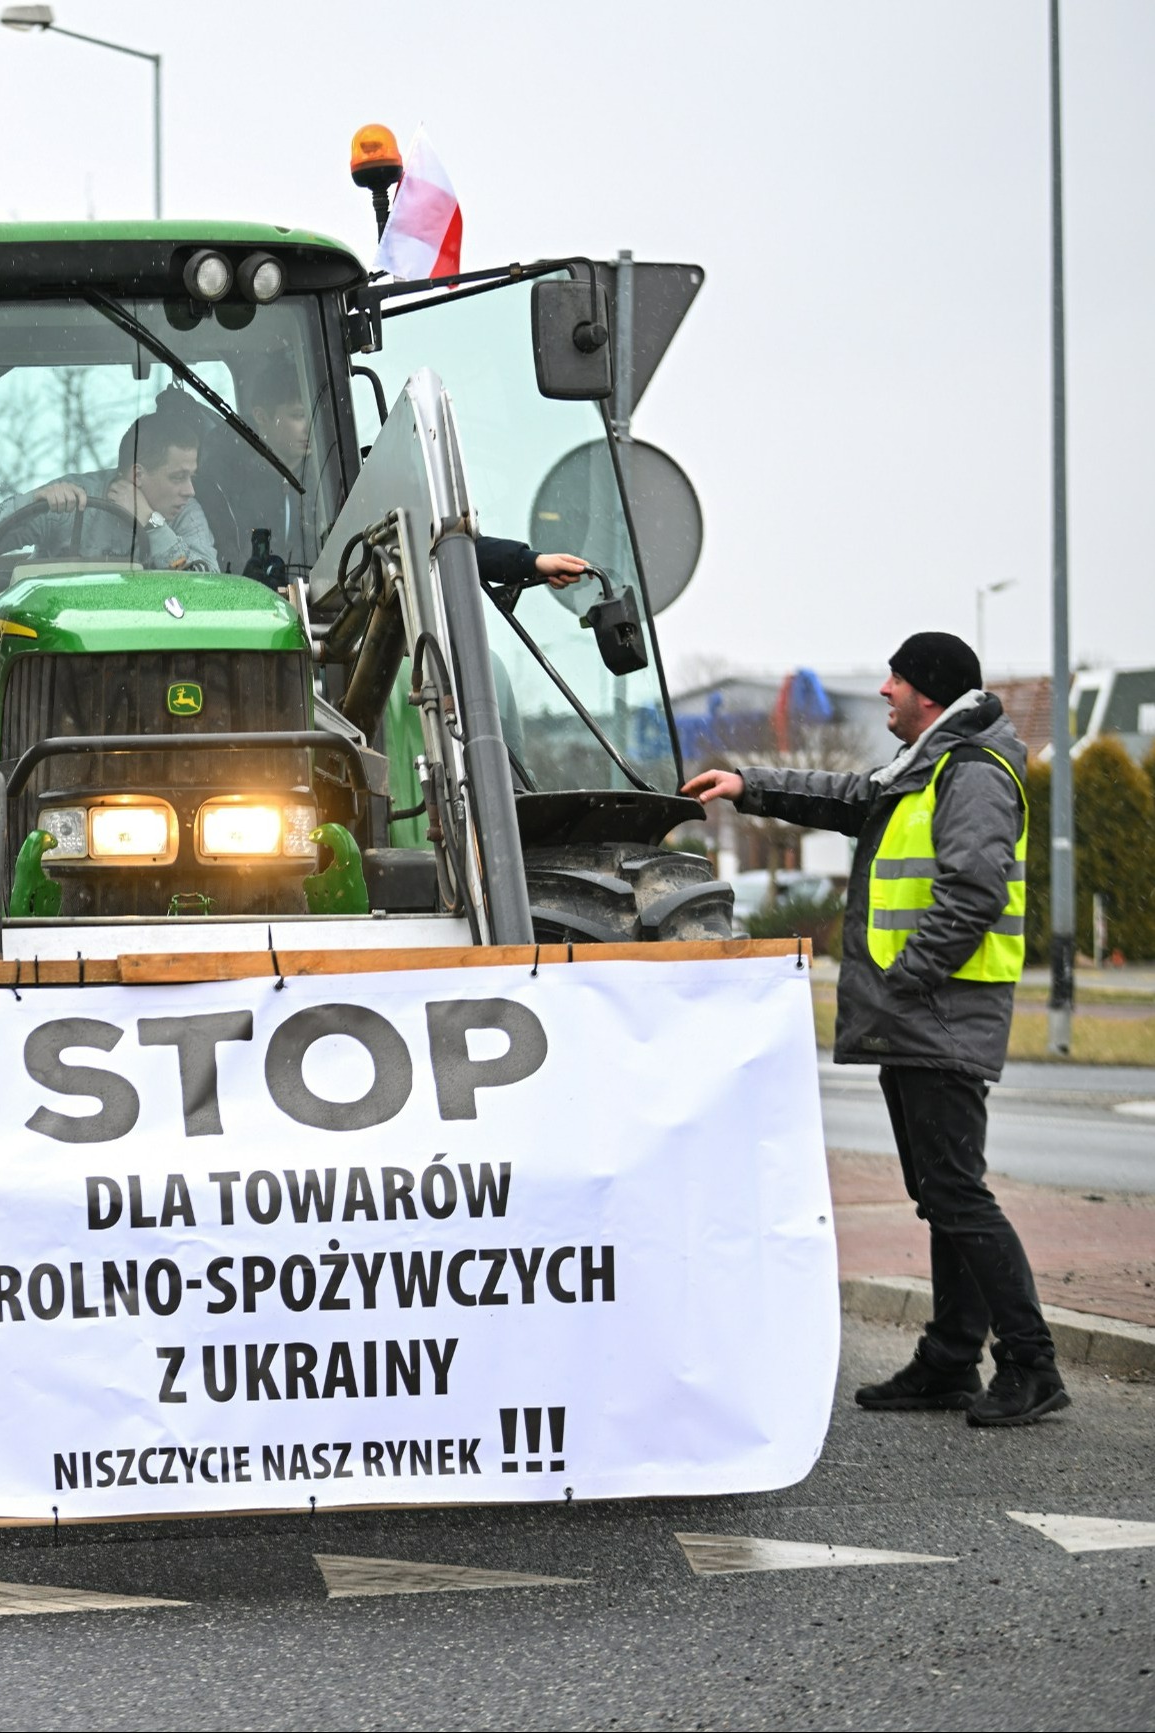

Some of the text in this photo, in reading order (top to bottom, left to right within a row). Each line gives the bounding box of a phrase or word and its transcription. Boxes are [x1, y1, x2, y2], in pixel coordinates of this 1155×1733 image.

[23, 998, 548, 1144] STOP
[86, 1153, 511, 1231] DLA TOWARÓW
[156, 1337, 459, 1404] Z UKRAINY
[53, 1406, 566, 1491] NISZCZYCIE NASZ RYNEK !!!
